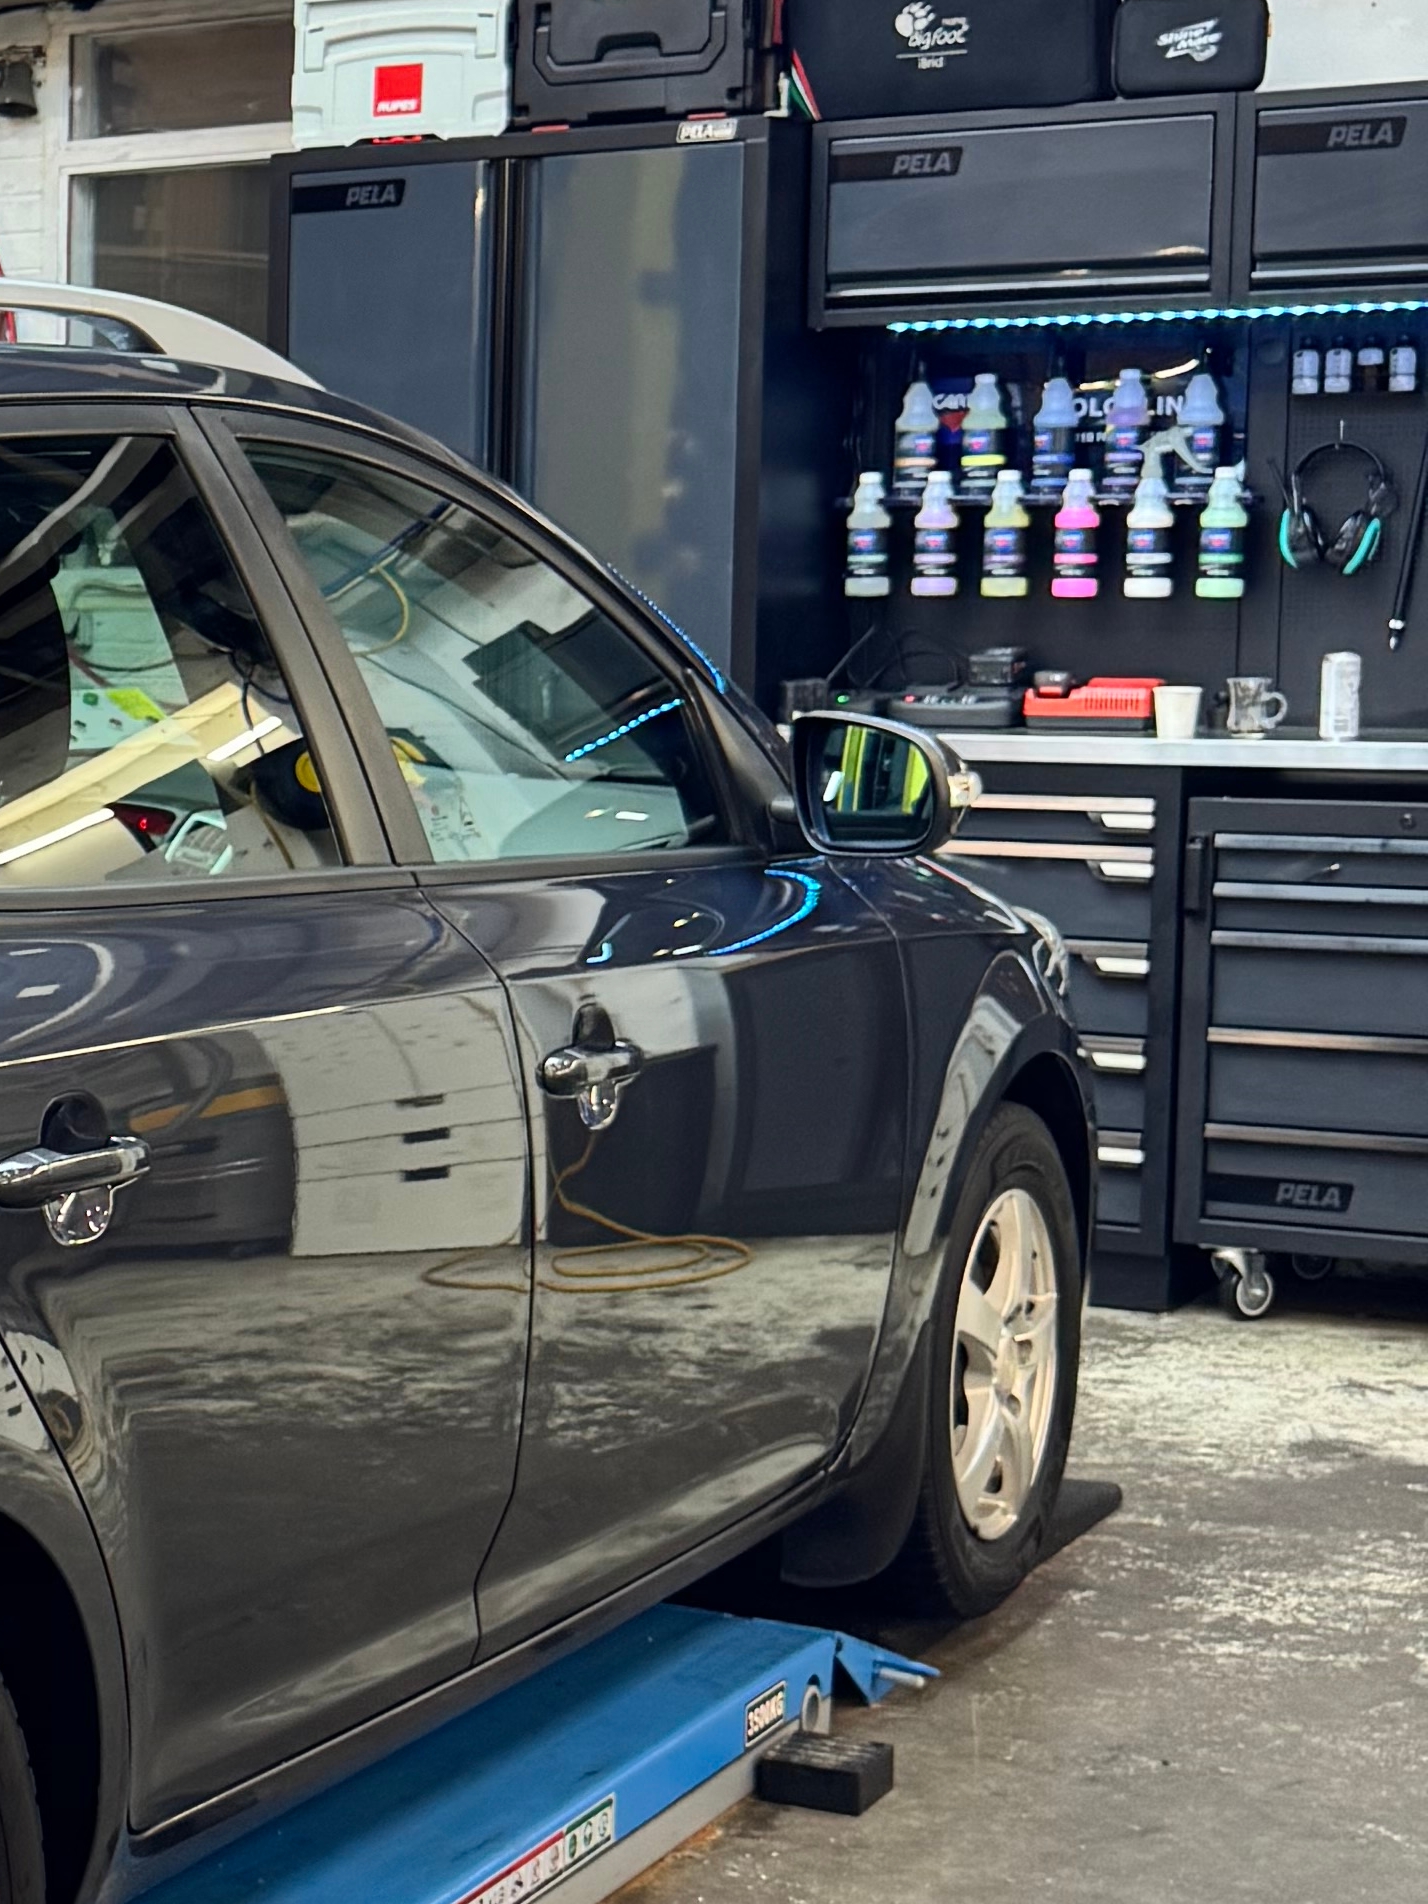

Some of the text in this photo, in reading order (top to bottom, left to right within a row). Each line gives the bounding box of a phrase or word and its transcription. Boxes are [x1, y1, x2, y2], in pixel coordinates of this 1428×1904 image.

[1327, 121, 1394, 148] PELA
[892, 152, 951, 176] PELA
[345, 184, 396, 207] PELA
[1276, 1182, 1341, 1209] PELA
